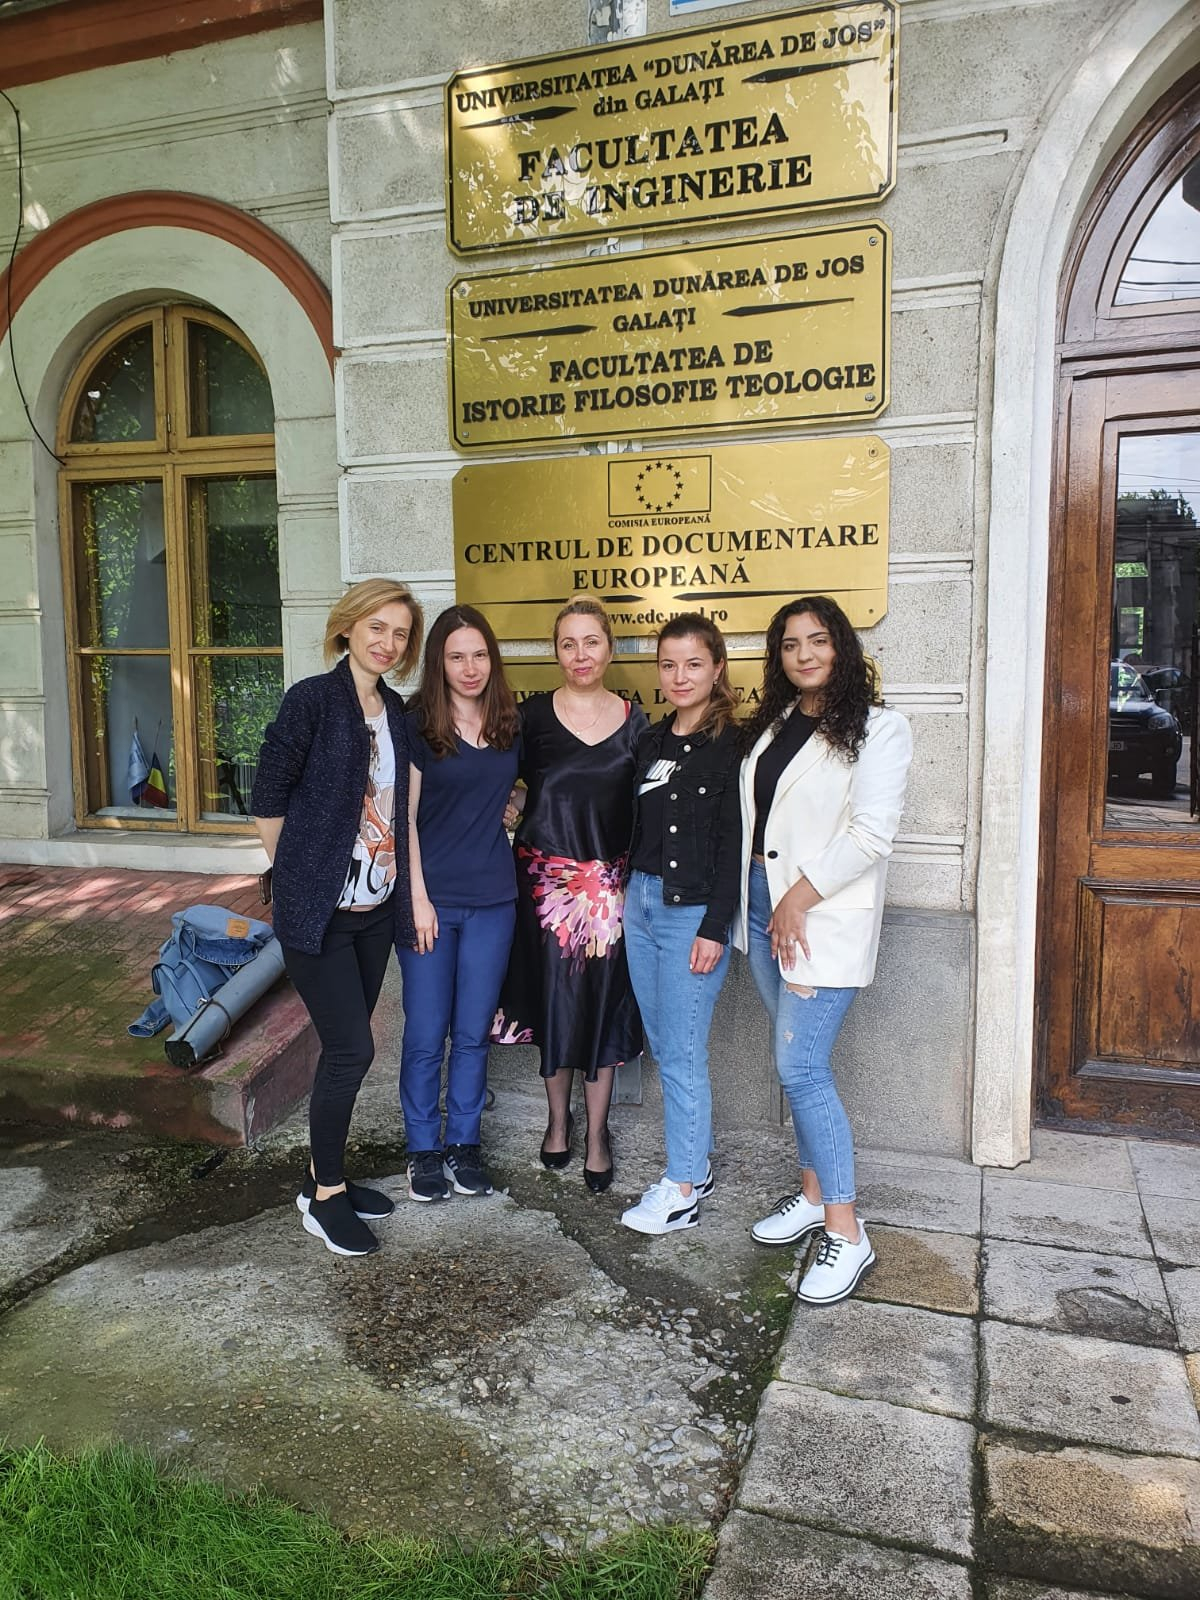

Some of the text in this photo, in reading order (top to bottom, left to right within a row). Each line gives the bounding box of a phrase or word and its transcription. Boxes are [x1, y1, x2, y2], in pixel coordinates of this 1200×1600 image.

[456, 63, 638, 113] UNIVERSITATEA
[781, 32, 816, 55] DE
[593, 96, 629, 117] din
[518, 112, 789, 182] FACULTATEA
[514, 155, 812, 224] DE INGINERIE
[469, 283, 642, 318] UNIVERSITATEA
[775, 262, 808, 283] DE
[816, 255, 864, 279] JOS
[549, 340, 773, 383] FACULTATEA DE
[462, 363, 876, 423] ISTORIE FILOSOFIE TEOLOGIE
[464, 524, 879, 564] CENTRUL DE DOCUMENTARE
[608, 519, 649, 528] COMISIA
[572, 556, 750, 590] EUROPEANĂ
